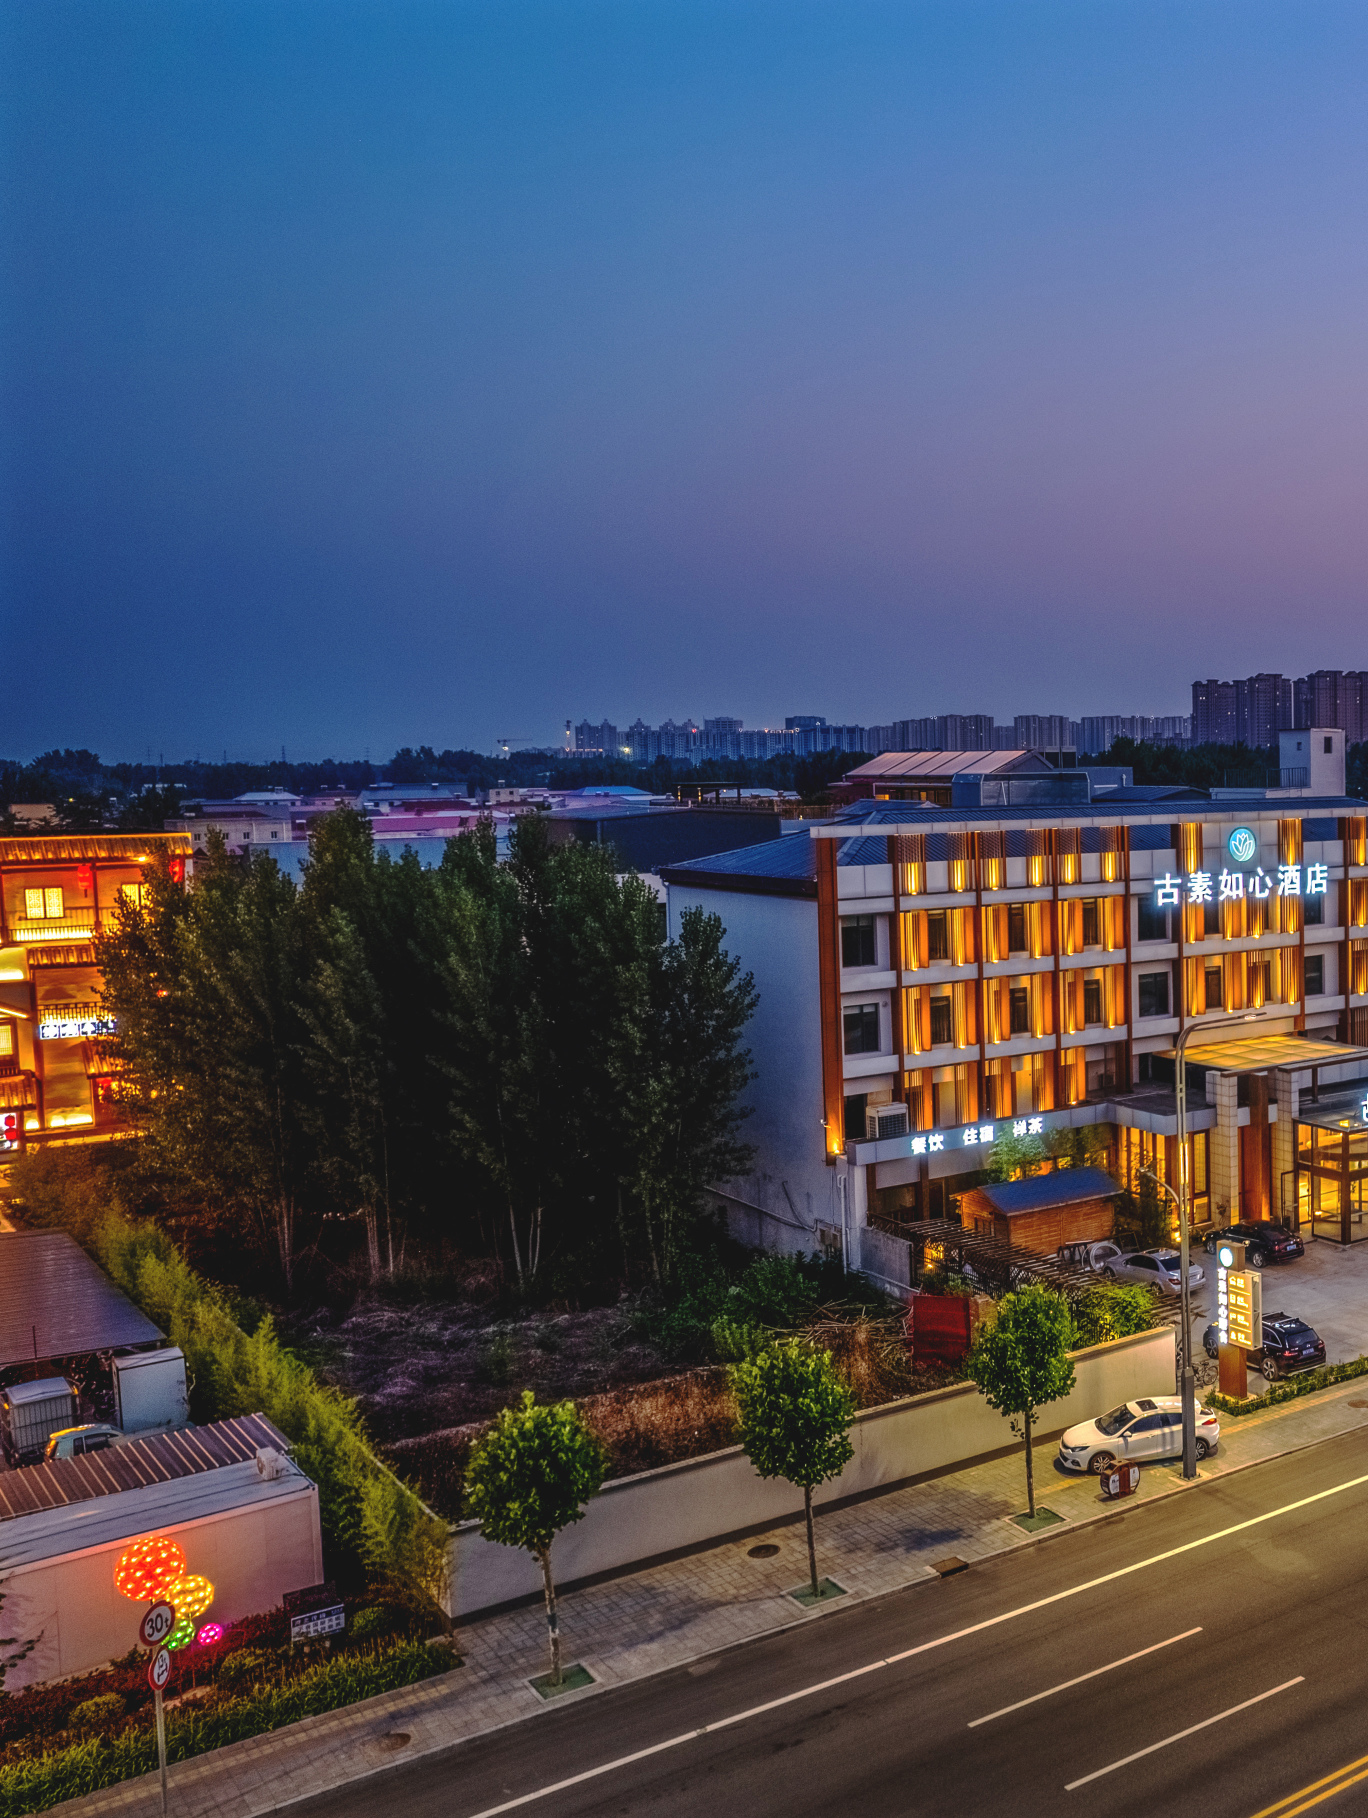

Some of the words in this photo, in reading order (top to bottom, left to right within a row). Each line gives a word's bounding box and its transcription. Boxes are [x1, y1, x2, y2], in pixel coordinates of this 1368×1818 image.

[1153, 862, 1329, 906] 古素如心酒店
[911, 1133, 945, 1155] 餐饮
[962, 1125, 994, 1146] 住宿
[146, 1612, 170, 1639] 30t
